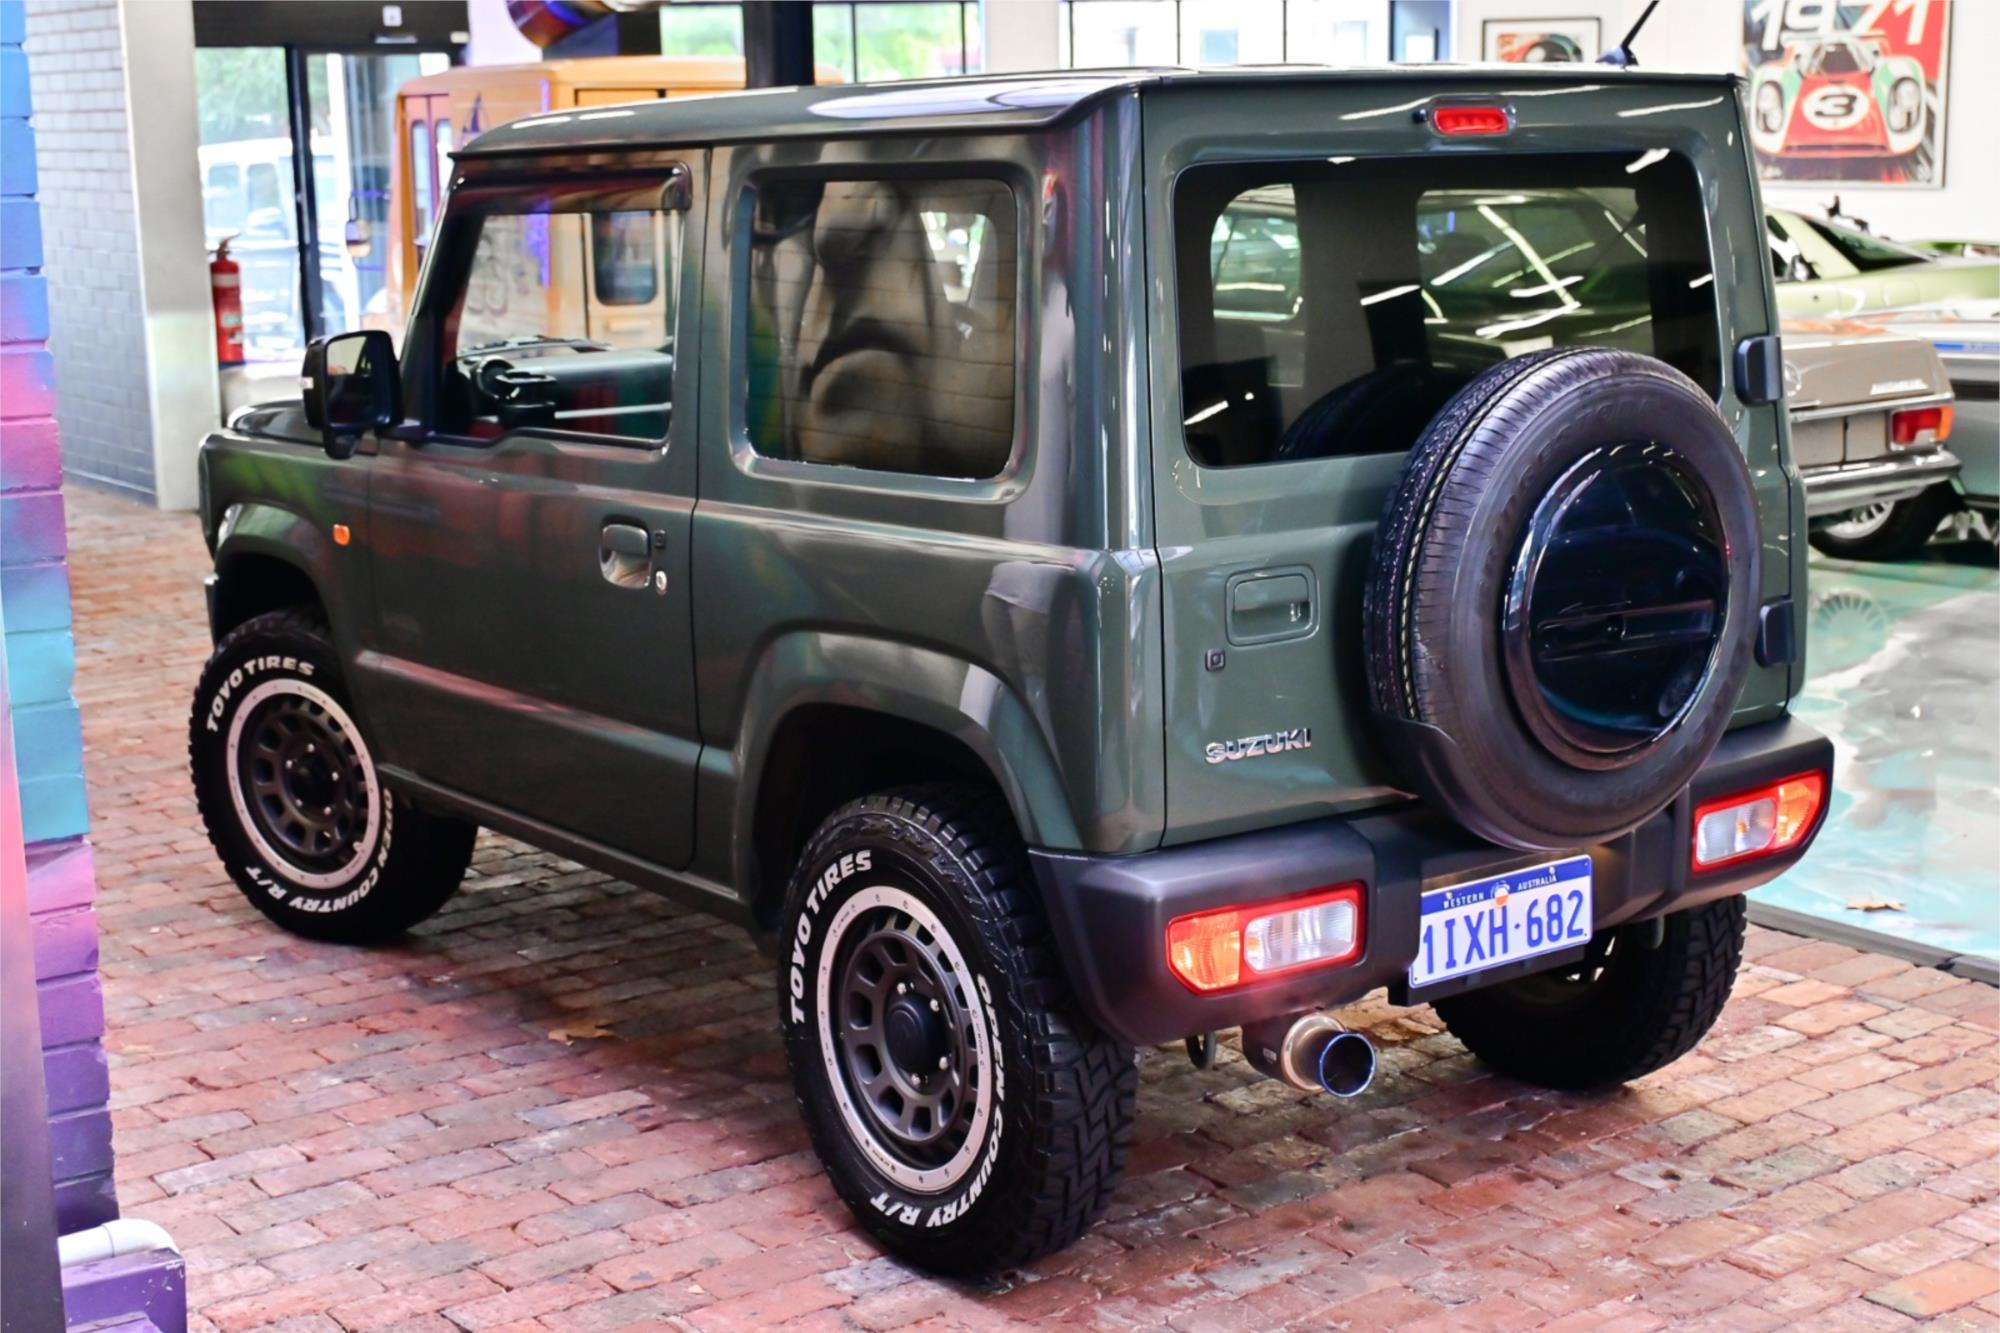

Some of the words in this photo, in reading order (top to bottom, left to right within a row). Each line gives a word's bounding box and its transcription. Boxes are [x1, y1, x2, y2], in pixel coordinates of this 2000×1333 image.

[1750, 0, 1931, 51] 1971
[1814, 93, 1857, 118] 3
[206, 669, 244, 732] TOYO
[244, 655, 315, 676] TIRES
[1205, 728, 1311, 764] SUZUKI
[246, 865, 288, 901] R/T
[289, 868, 380, 914] COUNTRY
[1443, 892, 1485, 909] WESTERN
[1517, 874, 1558, 891] AUSTRALIA
[790, 911, 813, 1025] TOYO
[806, 849, 873, 915] TIRES
[978, 973, 1005, 1102] OPEN
[925, 1107, 1005, 1229] COUNTRY
[870, 1193, 922, 1227] R/T
